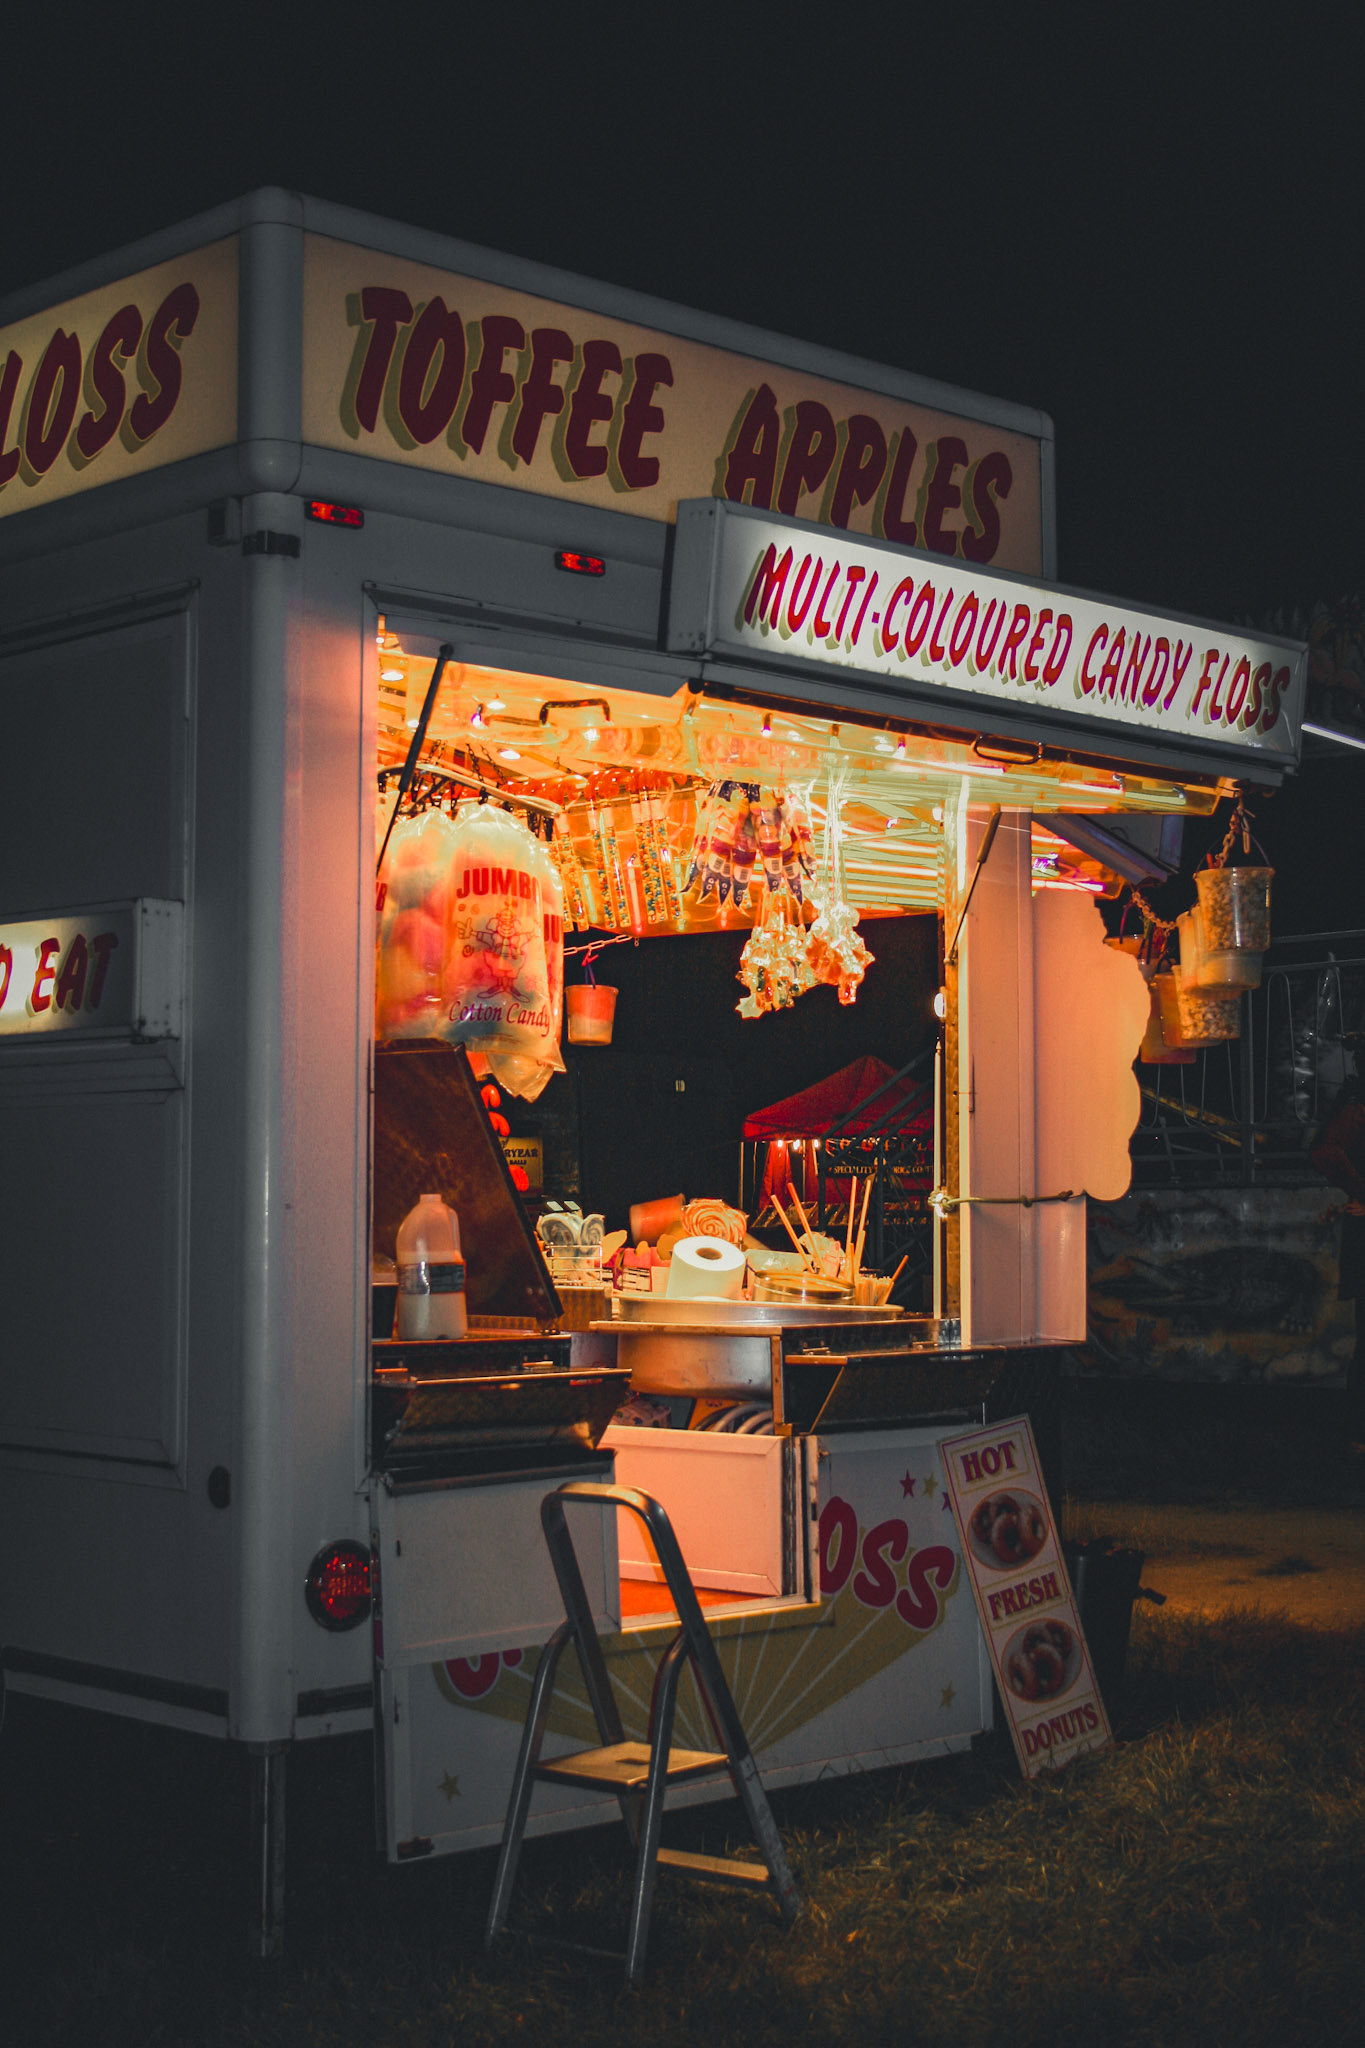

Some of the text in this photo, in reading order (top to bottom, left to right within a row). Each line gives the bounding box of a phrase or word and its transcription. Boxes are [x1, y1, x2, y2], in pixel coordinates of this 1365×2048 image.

[342, 286, 1013, 564] TOFFEE APPLES
[742, 542, 1290, 733] MULTI-COLOURED CANDY FLOSS
[29, 932, 119, 1014] EAT
[449, 1001, 550, 1037] Cotton Candy
[960, 1440, 1018, 1483] HOT
[987, 1571, 1061, 1622] FRESH
[1021, 1702, 1099, 1757] DONUTS
